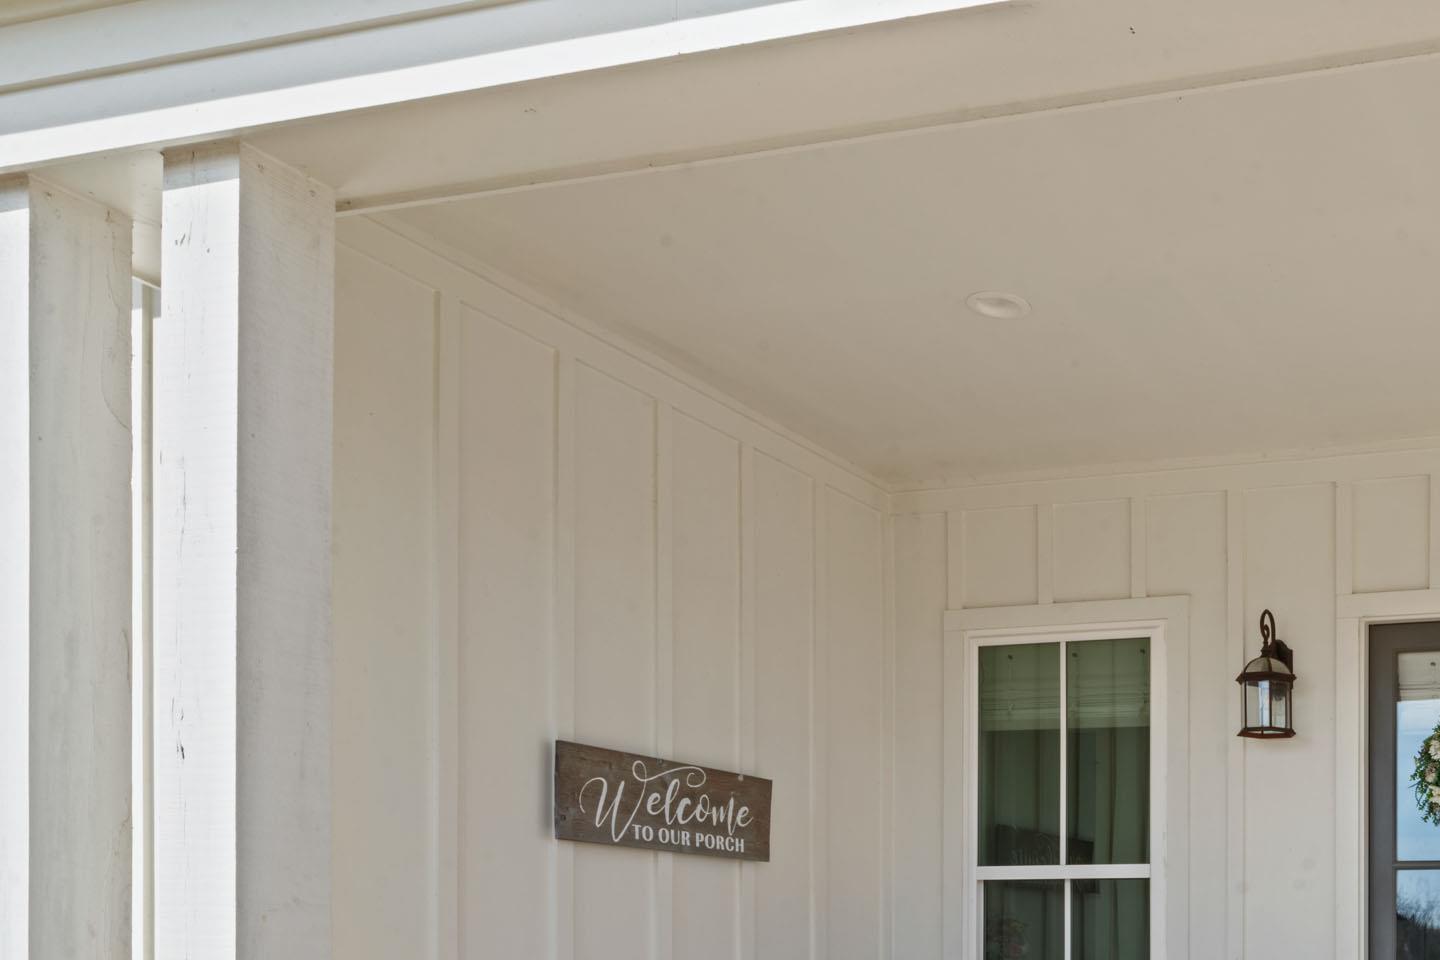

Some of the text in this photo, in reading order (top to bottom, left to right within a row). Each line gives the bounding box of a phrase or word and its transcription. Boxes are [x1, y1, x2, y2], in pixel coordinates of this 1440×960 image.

[579, 760, 753, 842] Welcome
[632, 824, 745, 853] TO OUR PORCH
